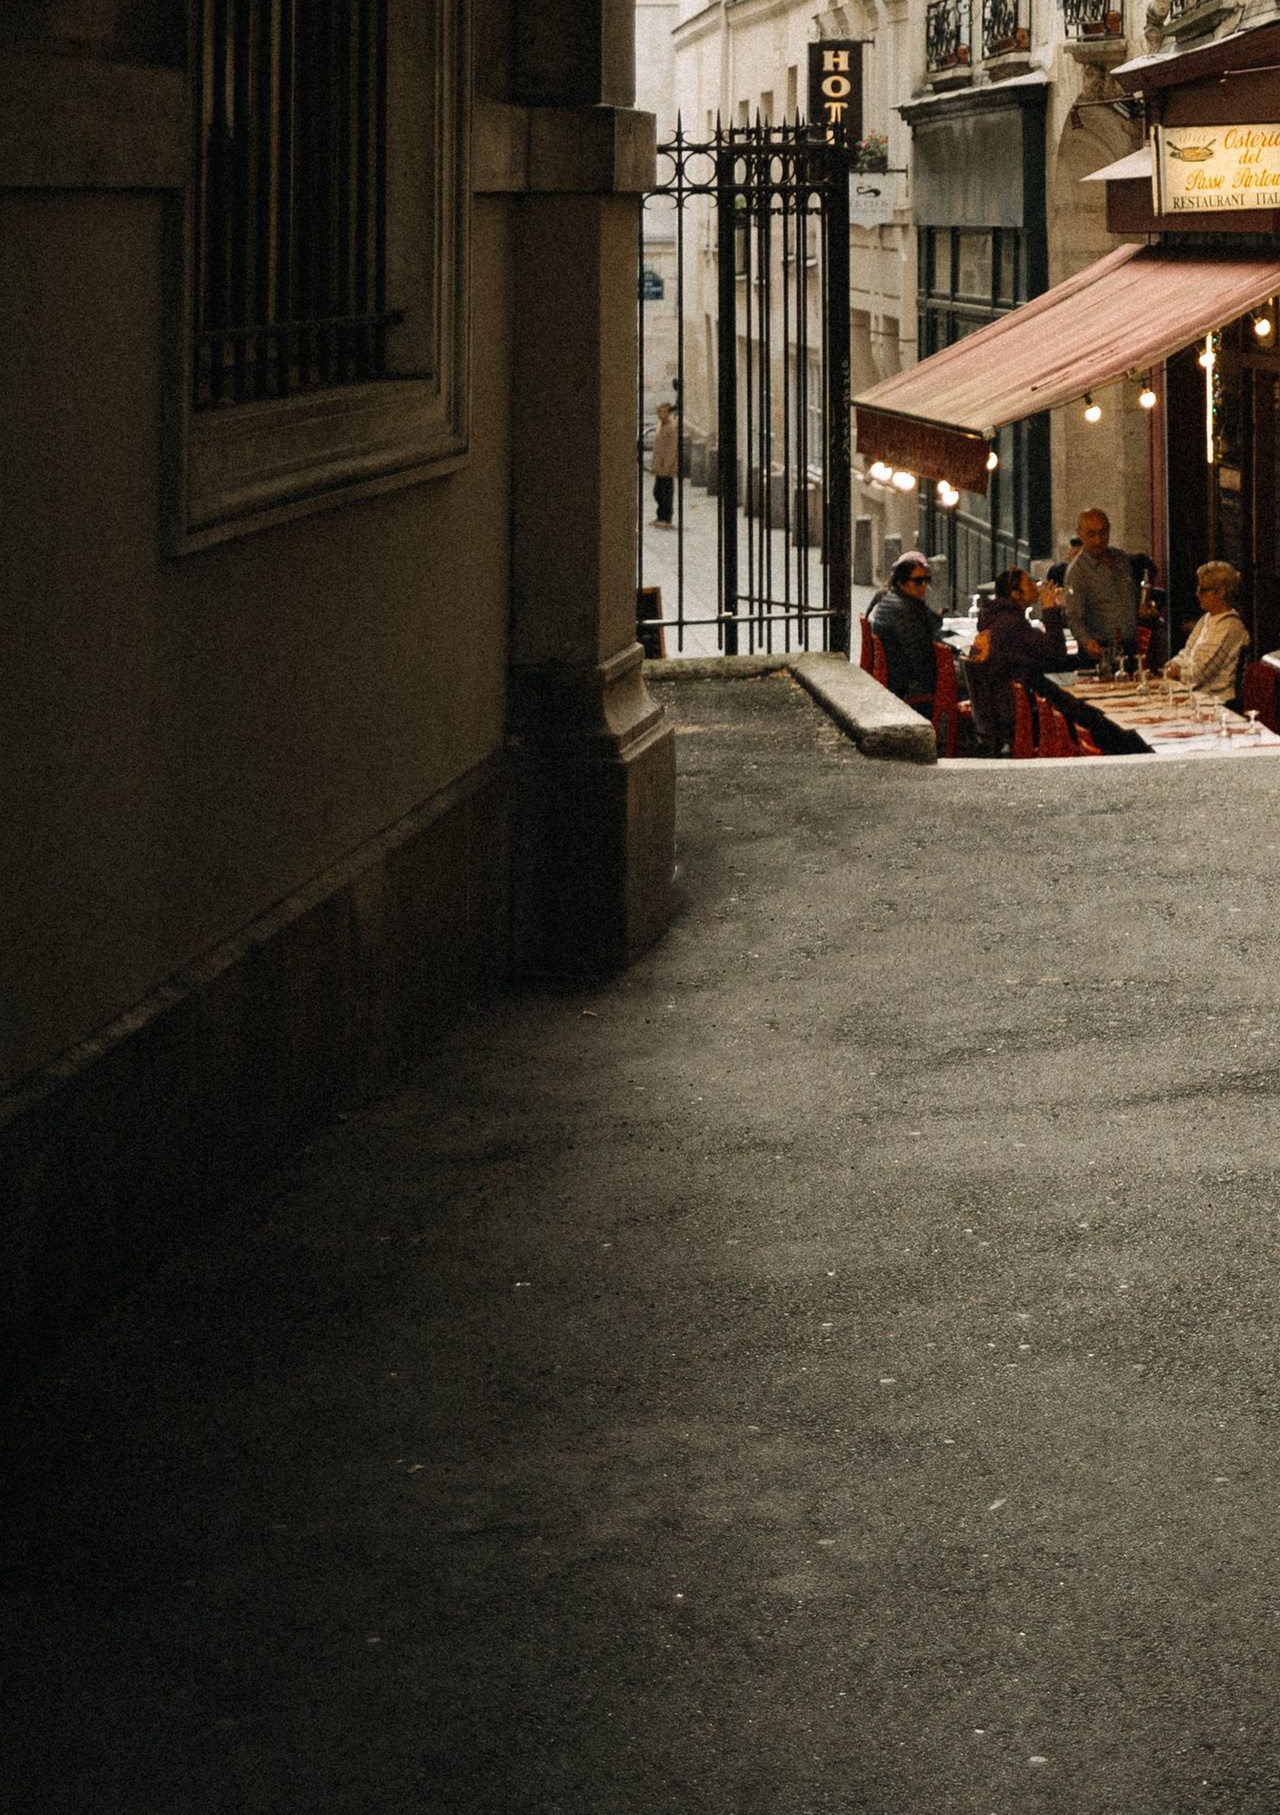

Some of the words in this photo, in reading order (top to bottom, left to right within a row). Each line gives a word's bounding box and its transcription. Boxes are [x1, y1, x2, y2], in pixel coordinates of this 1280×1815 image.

[1238, 148, 1262, 165] del
[1185, 169, 1226, 191] Passe
[1173, 192, 1246, 210] RESTAURANT
